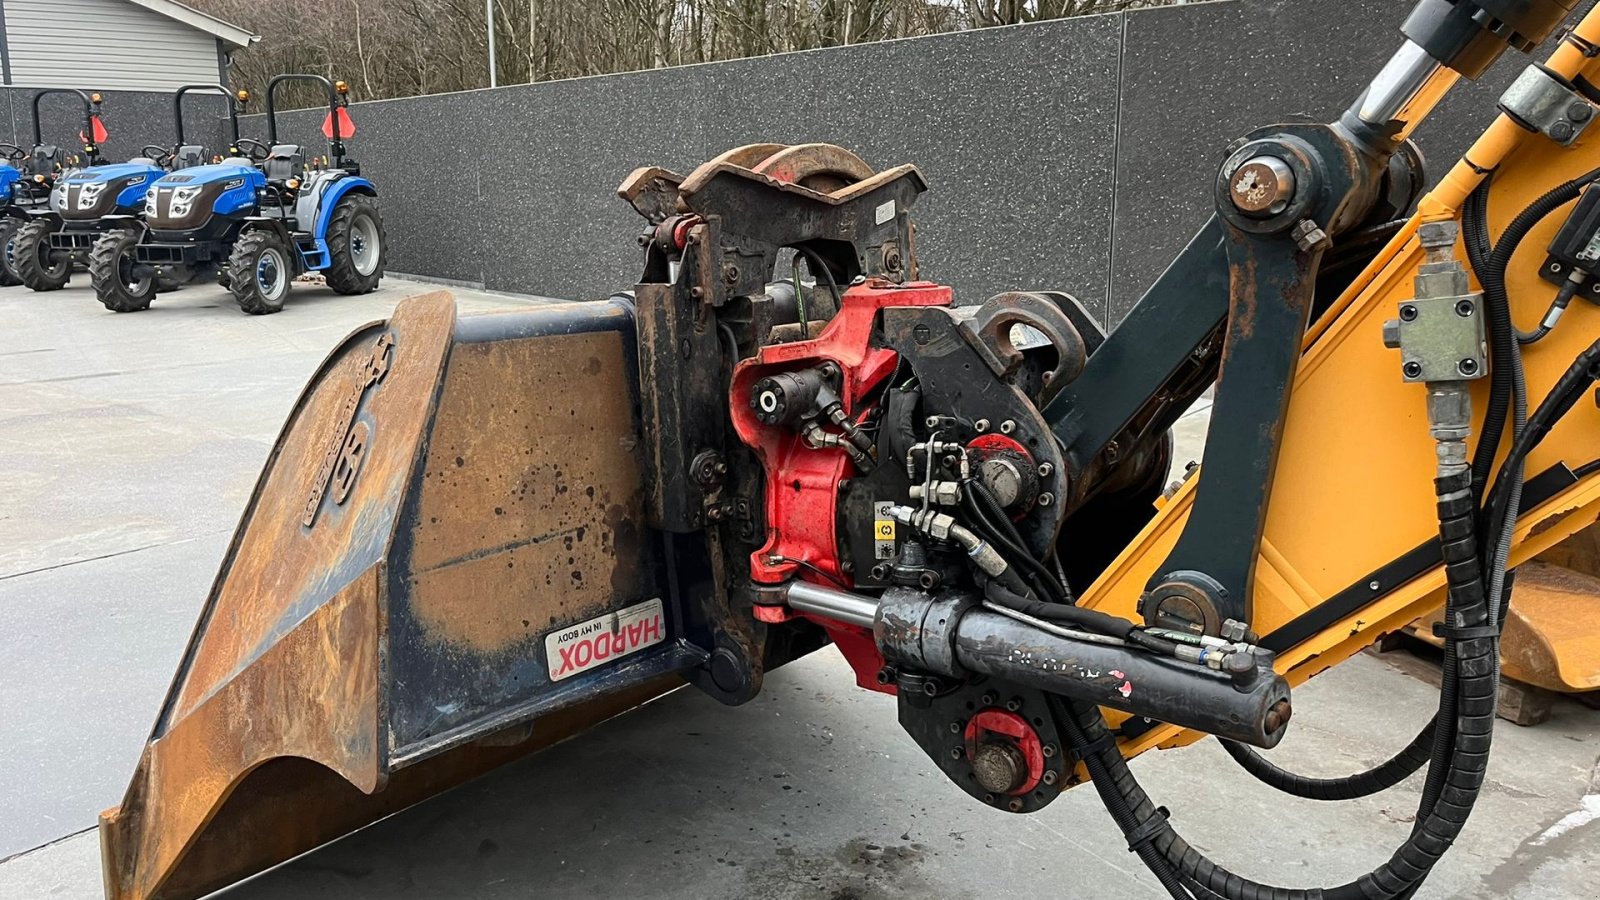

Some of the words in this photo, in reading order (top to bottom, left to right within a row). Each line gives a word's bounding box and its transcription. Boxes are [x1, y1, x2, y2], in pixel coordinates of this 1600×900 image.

[581, 624, 592, 636] MY
[594, 621, 602, 632] IN
[557, 629, 579, 645] BODY
[559, 614, 660, 676] HARDOX
